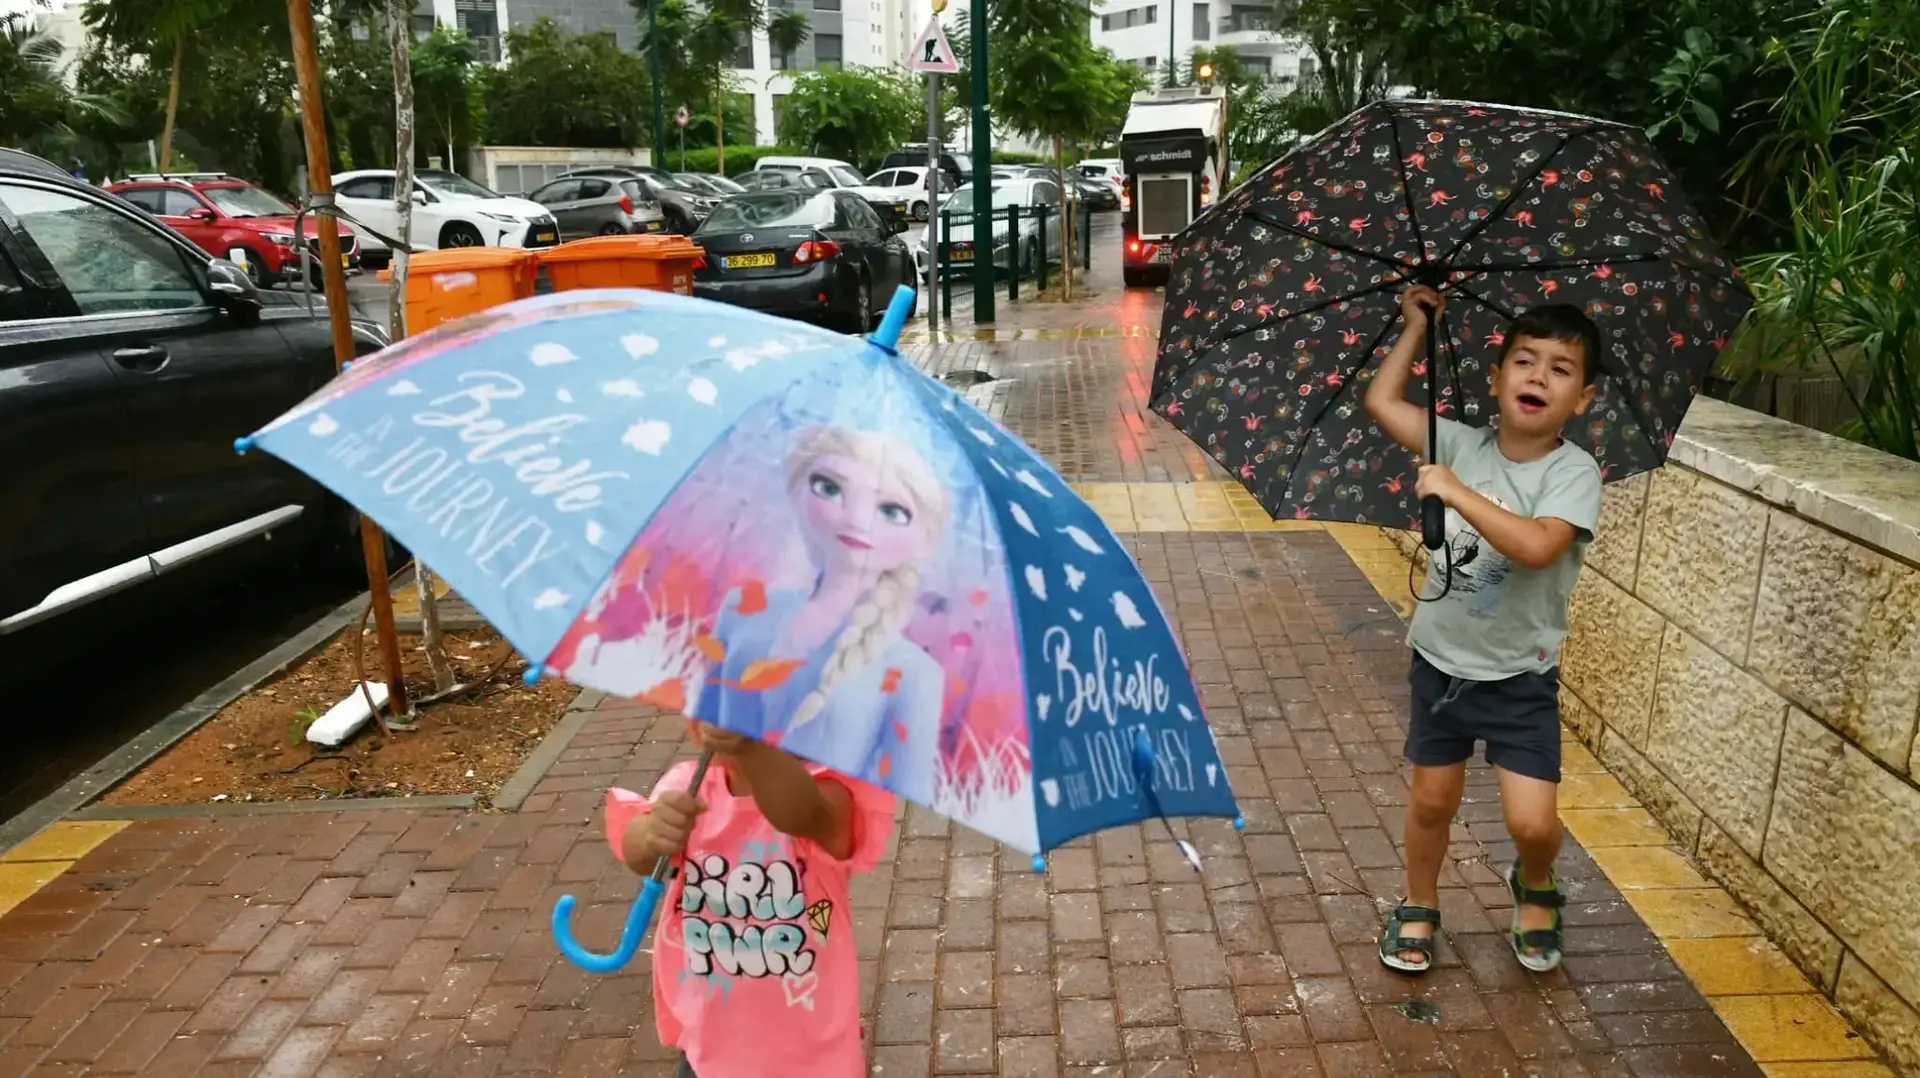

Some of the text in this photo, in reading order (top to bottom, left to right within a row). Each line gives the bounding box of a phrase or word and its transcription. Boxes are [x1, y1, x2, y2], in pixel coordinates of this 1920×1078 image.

[1150, 149, 1193, 161] schmidt
[361, 436, 569, 589] JOURNEY
[681, 915, 816, 979] PWR
